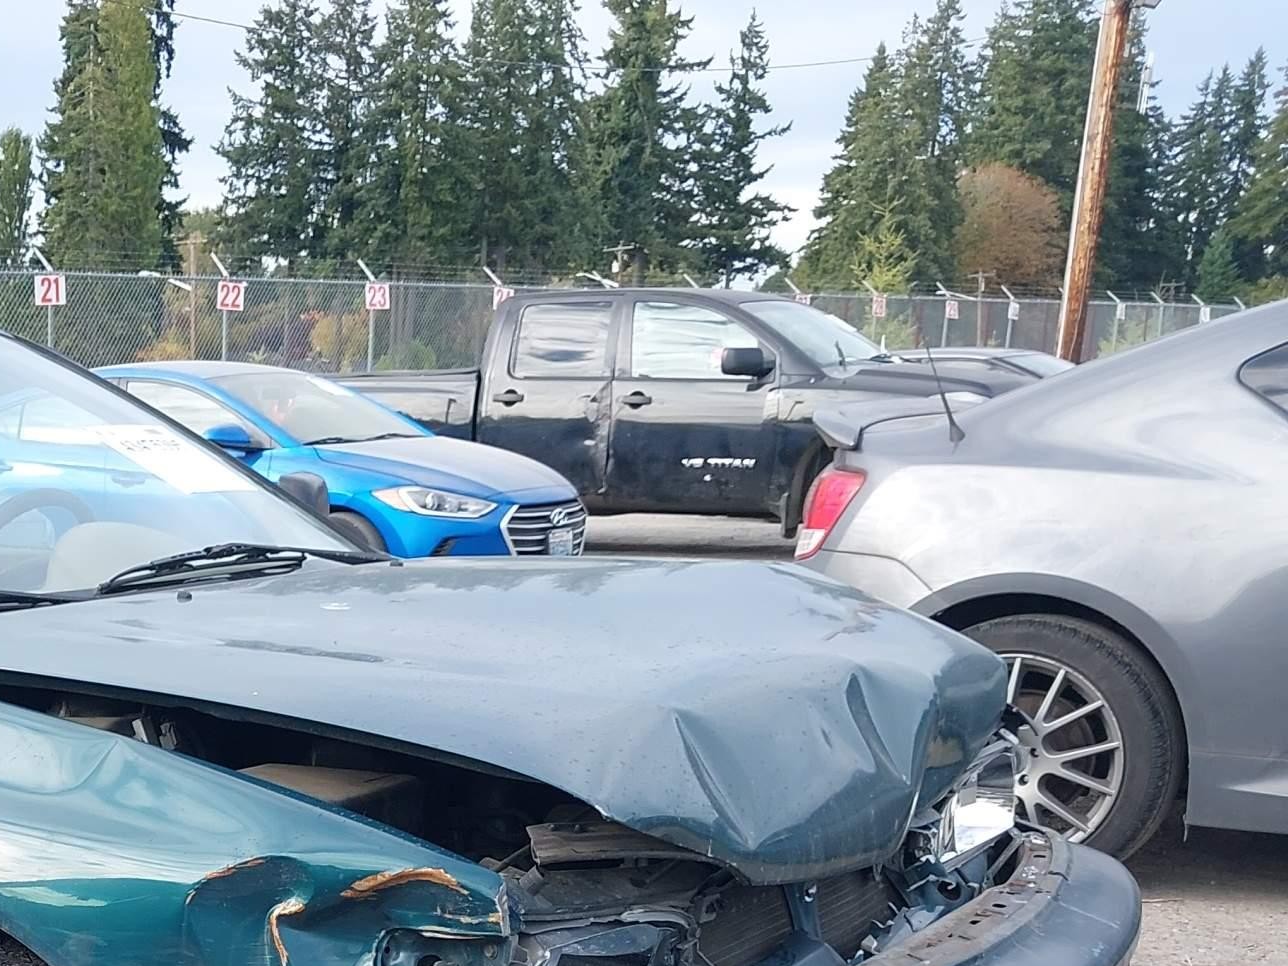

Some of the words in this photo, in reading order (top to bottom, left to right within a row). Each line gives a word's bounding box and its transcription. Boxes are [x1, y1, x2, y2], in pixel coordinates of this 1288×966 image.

[41, 277, 60, 303] 21
[220, 284, 241, 308] 22
[368, 286, 387, 307] 23
[706, 457, 757, 468] TITAN
